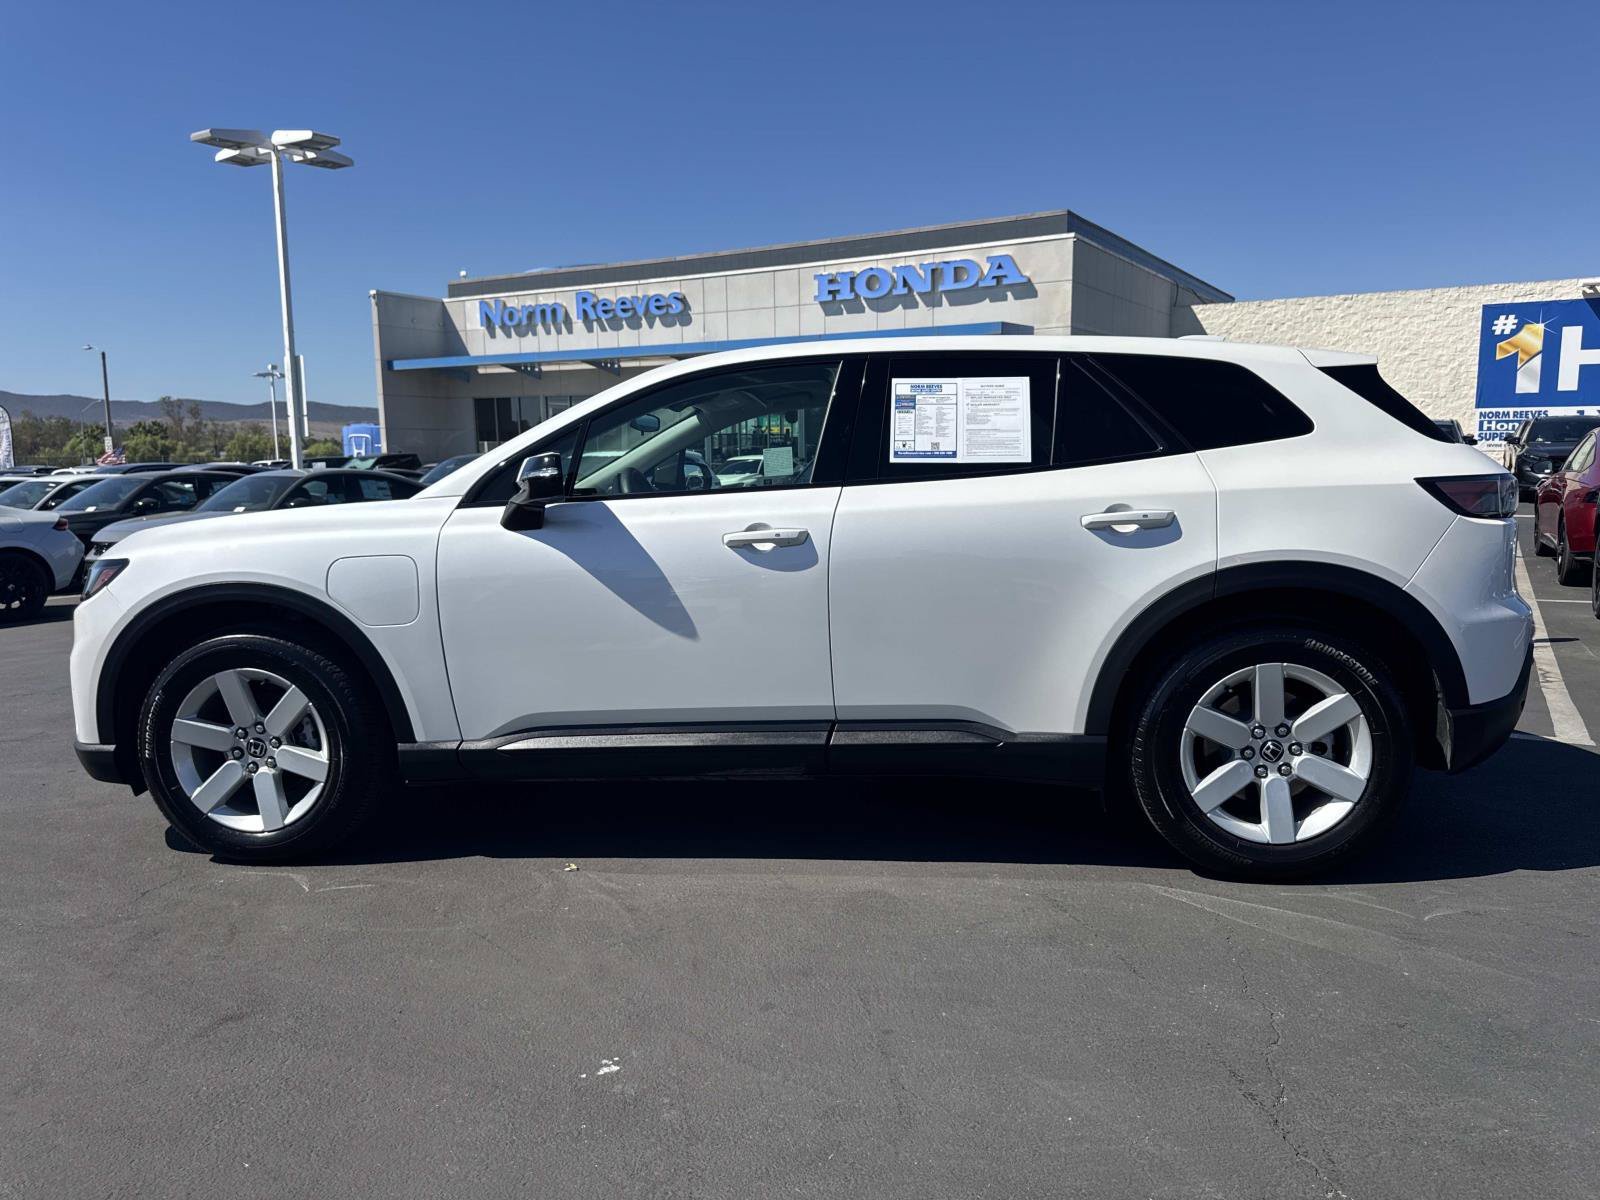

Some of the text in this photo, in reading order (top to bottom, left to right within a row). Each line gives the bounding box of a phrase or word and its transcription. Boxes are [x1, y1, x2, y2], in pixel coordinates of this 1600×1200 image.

[815, 255, 1028, 302] HONDA
[480, 290, 686, 328] Norm Reeves
[1479, 410, 1549, 419] NORM REEVES
[1482, 421, 1520, 431] Hon
[1304, 638, 1379, 685] BRIDGESTONE
